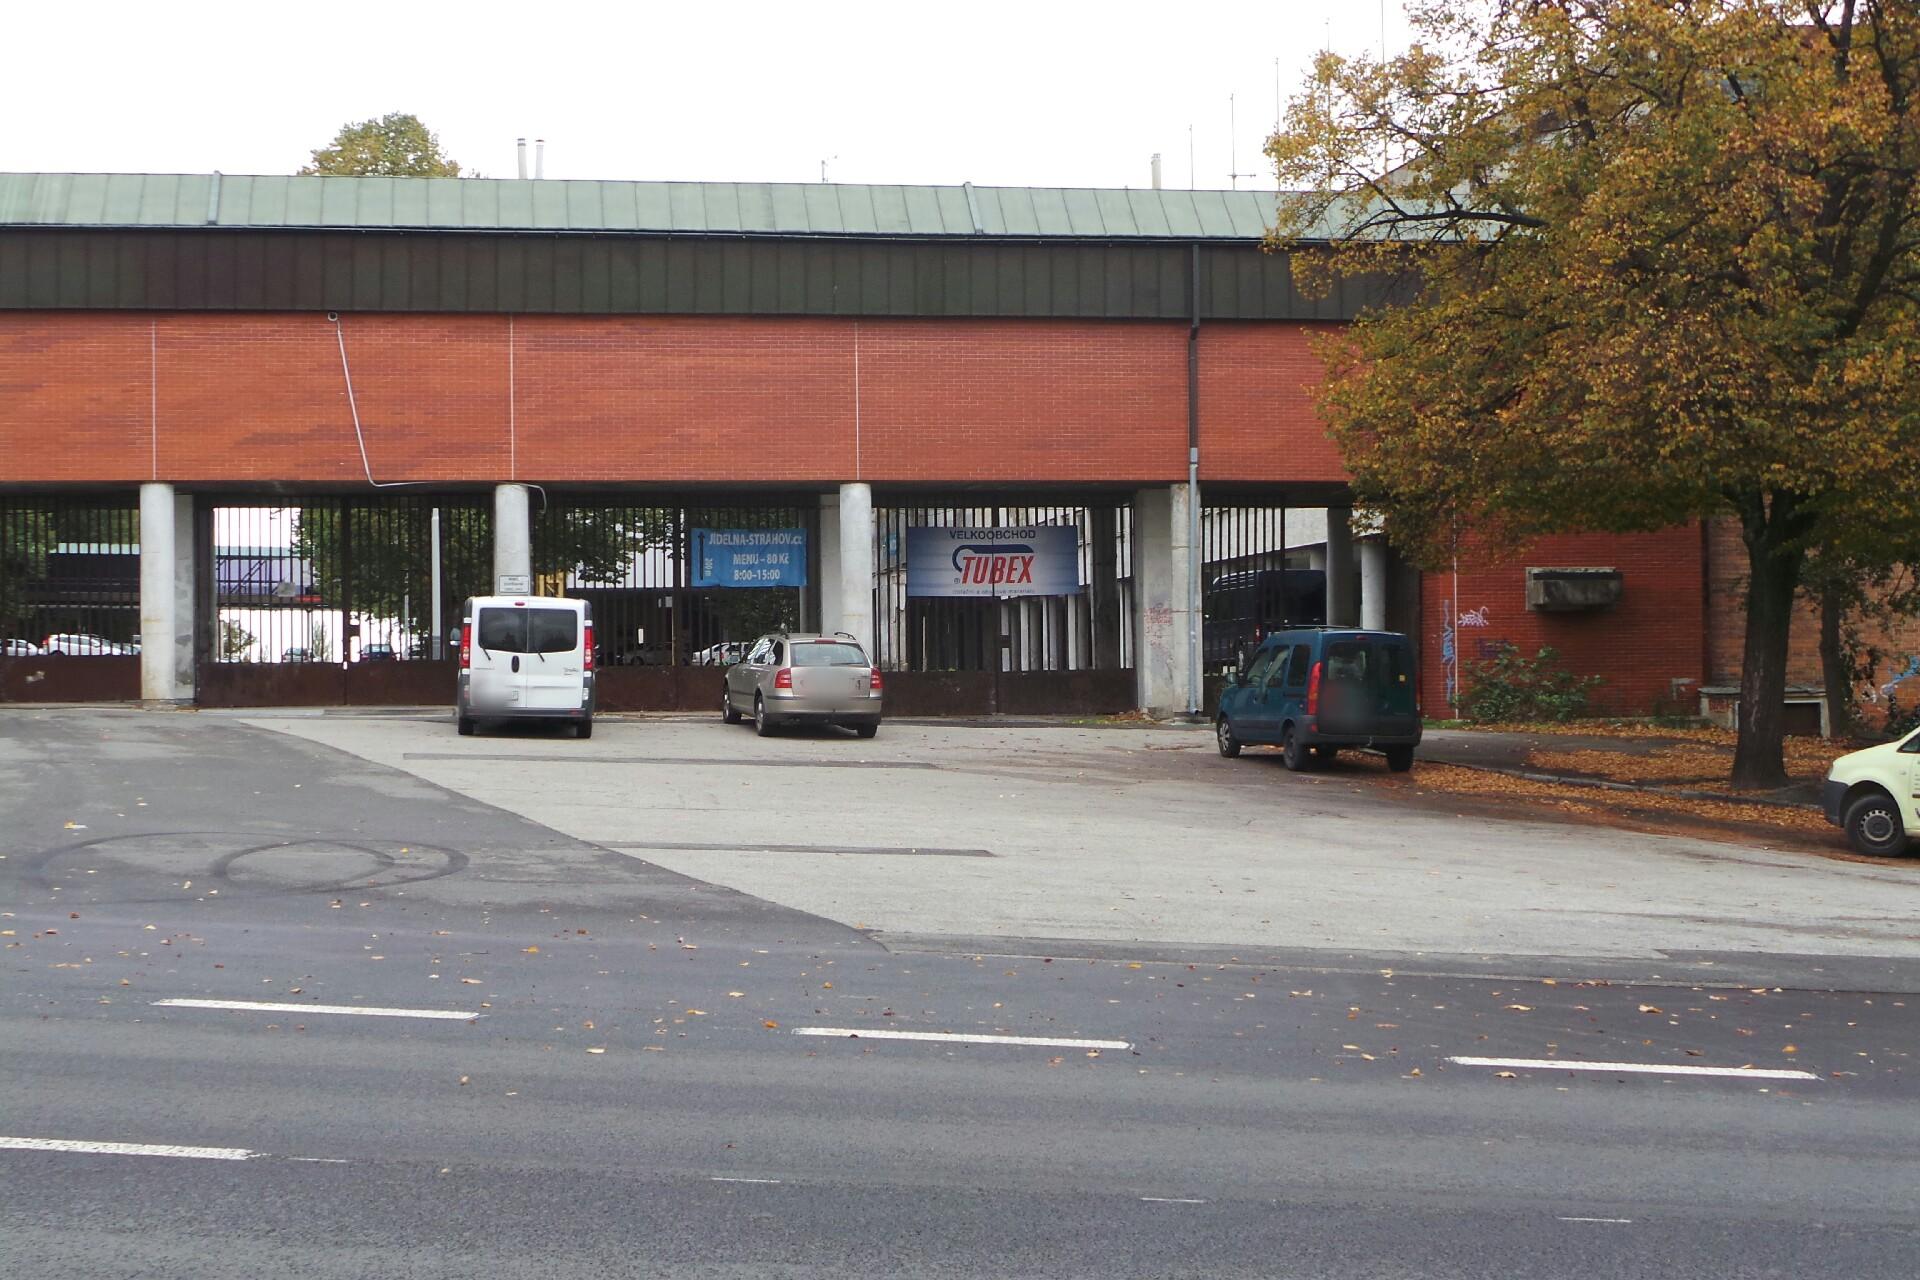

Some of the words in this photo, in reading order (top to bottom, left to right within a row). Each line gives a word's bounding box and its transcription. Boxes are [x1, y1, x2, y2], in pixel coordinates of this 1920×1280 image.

[950, 530, 1036, 540] VELKOOBCHOD
[733, 553, 758, 565] MENU
[961, 556, 1035, 584] TUBEX
